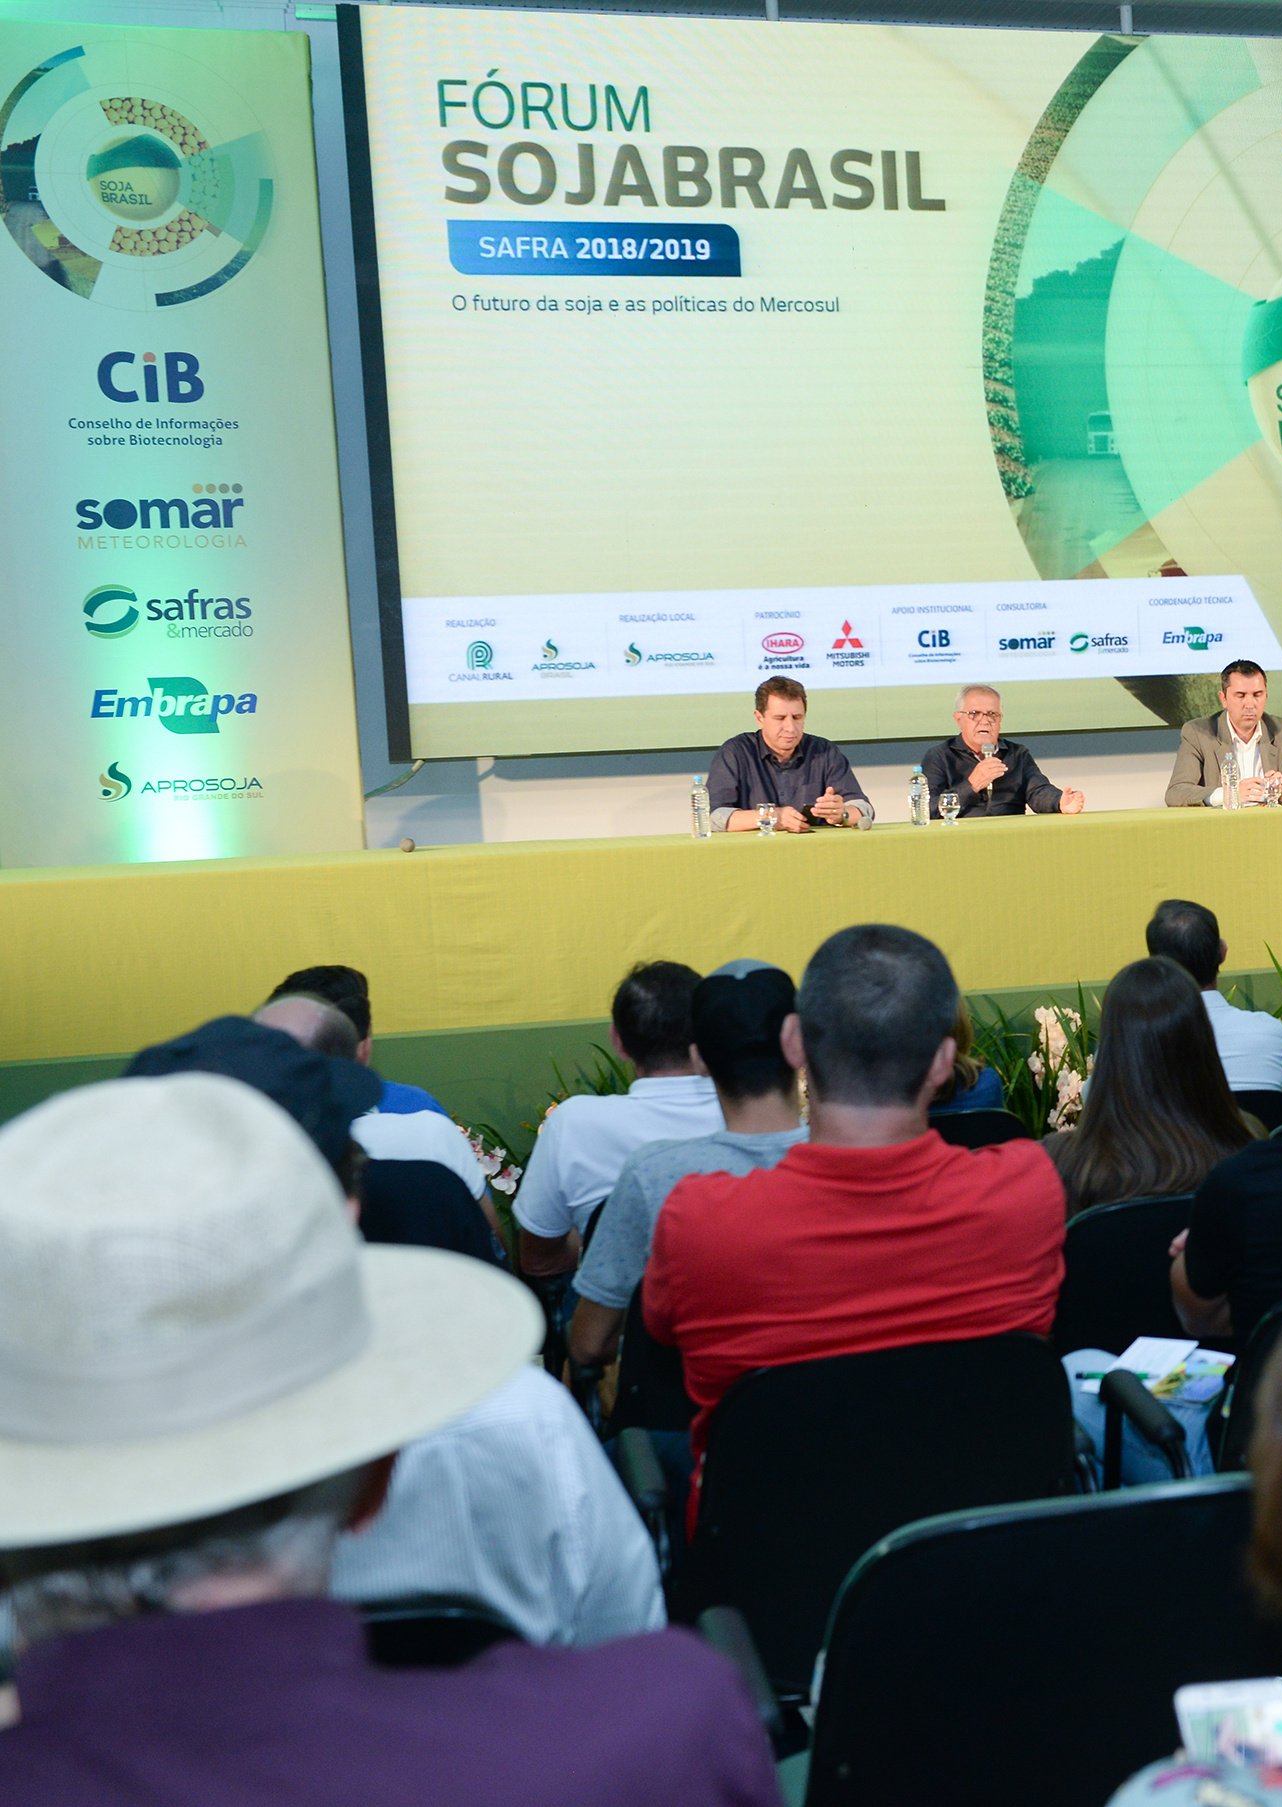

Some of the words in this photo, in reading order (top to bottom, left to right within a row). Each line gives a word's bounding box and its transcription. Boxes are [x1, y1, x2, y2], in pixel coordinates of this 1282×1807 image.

[436, 68, 651, 132] FÓRUM
[441, 139, 946, 212] SOJABRASIL
[99, 180, 134, 192] SOJA
[100, 192, 152, 205] BRASIL
[478, 236, 569, 260] SAFRA
[575, 238, 711, 261] 2018/2019
[452, 295, 467, 311] O
[473, 295, 530, 311] futuro
[536, 296, 559, 311] da
[564, 296, 603, 315] soja
[609, 299, 620, 312] e
[625, 299, 646, 312] as
[652, 296, 728, 315] políticas
[733, 297, 755, 313] do
[760, 297, 840, 313] Mercosul
[68, 418, 132, 429] Conselho
[136, 418, 152, 429] de
[156, 418, 239, 432] Informações
[88, 435, 125, 446] sobre
[130, 435, 222, 448] Biotecnologia
[75, 498, 244, 531] somar
[77, 534, 247, 549] METEOROLOGIA
[146, 588, 252, 621] safras
[996, 602, 1047, 611] CONSULTORIA
[1149, 596, 1202, 606] COORDENAÇÃO
[1204, 596, 1233, 604] TÉCNICA
[755, 610, 801, 619] PATROCÍNIO
[892, 606, 915, 614] APOIO
[917, 604, 974, 614] INSTITUCIONAL
[445, 618, 496, 629] REALIZAÇÃO
[619, 612, 668, 623] REALIZAÇÃO
[670, 613, 695, 621] LOCAL
[166, 622, 254, 638] &mercado
[767, 640, 799, 648] IHARA
[999, 636, 1055, 650] somar
[1091, 633, 1128, 647] safras
[1162, 631, 1223, 645] Embrapa
[647, 652, 714, 662] APROSOJA
[764, 655, 804, 664] Agricultura
[531, 662, 596, 671] APROSOJA
[833, 660, 865, 668] MOTORS
[90, 688, 258, 722] Embrapa
[140, 777, 264, 794] APROSOJA
[192, 792, 228, 800] GRANDE
[246, 791, 264, 799] SUL
